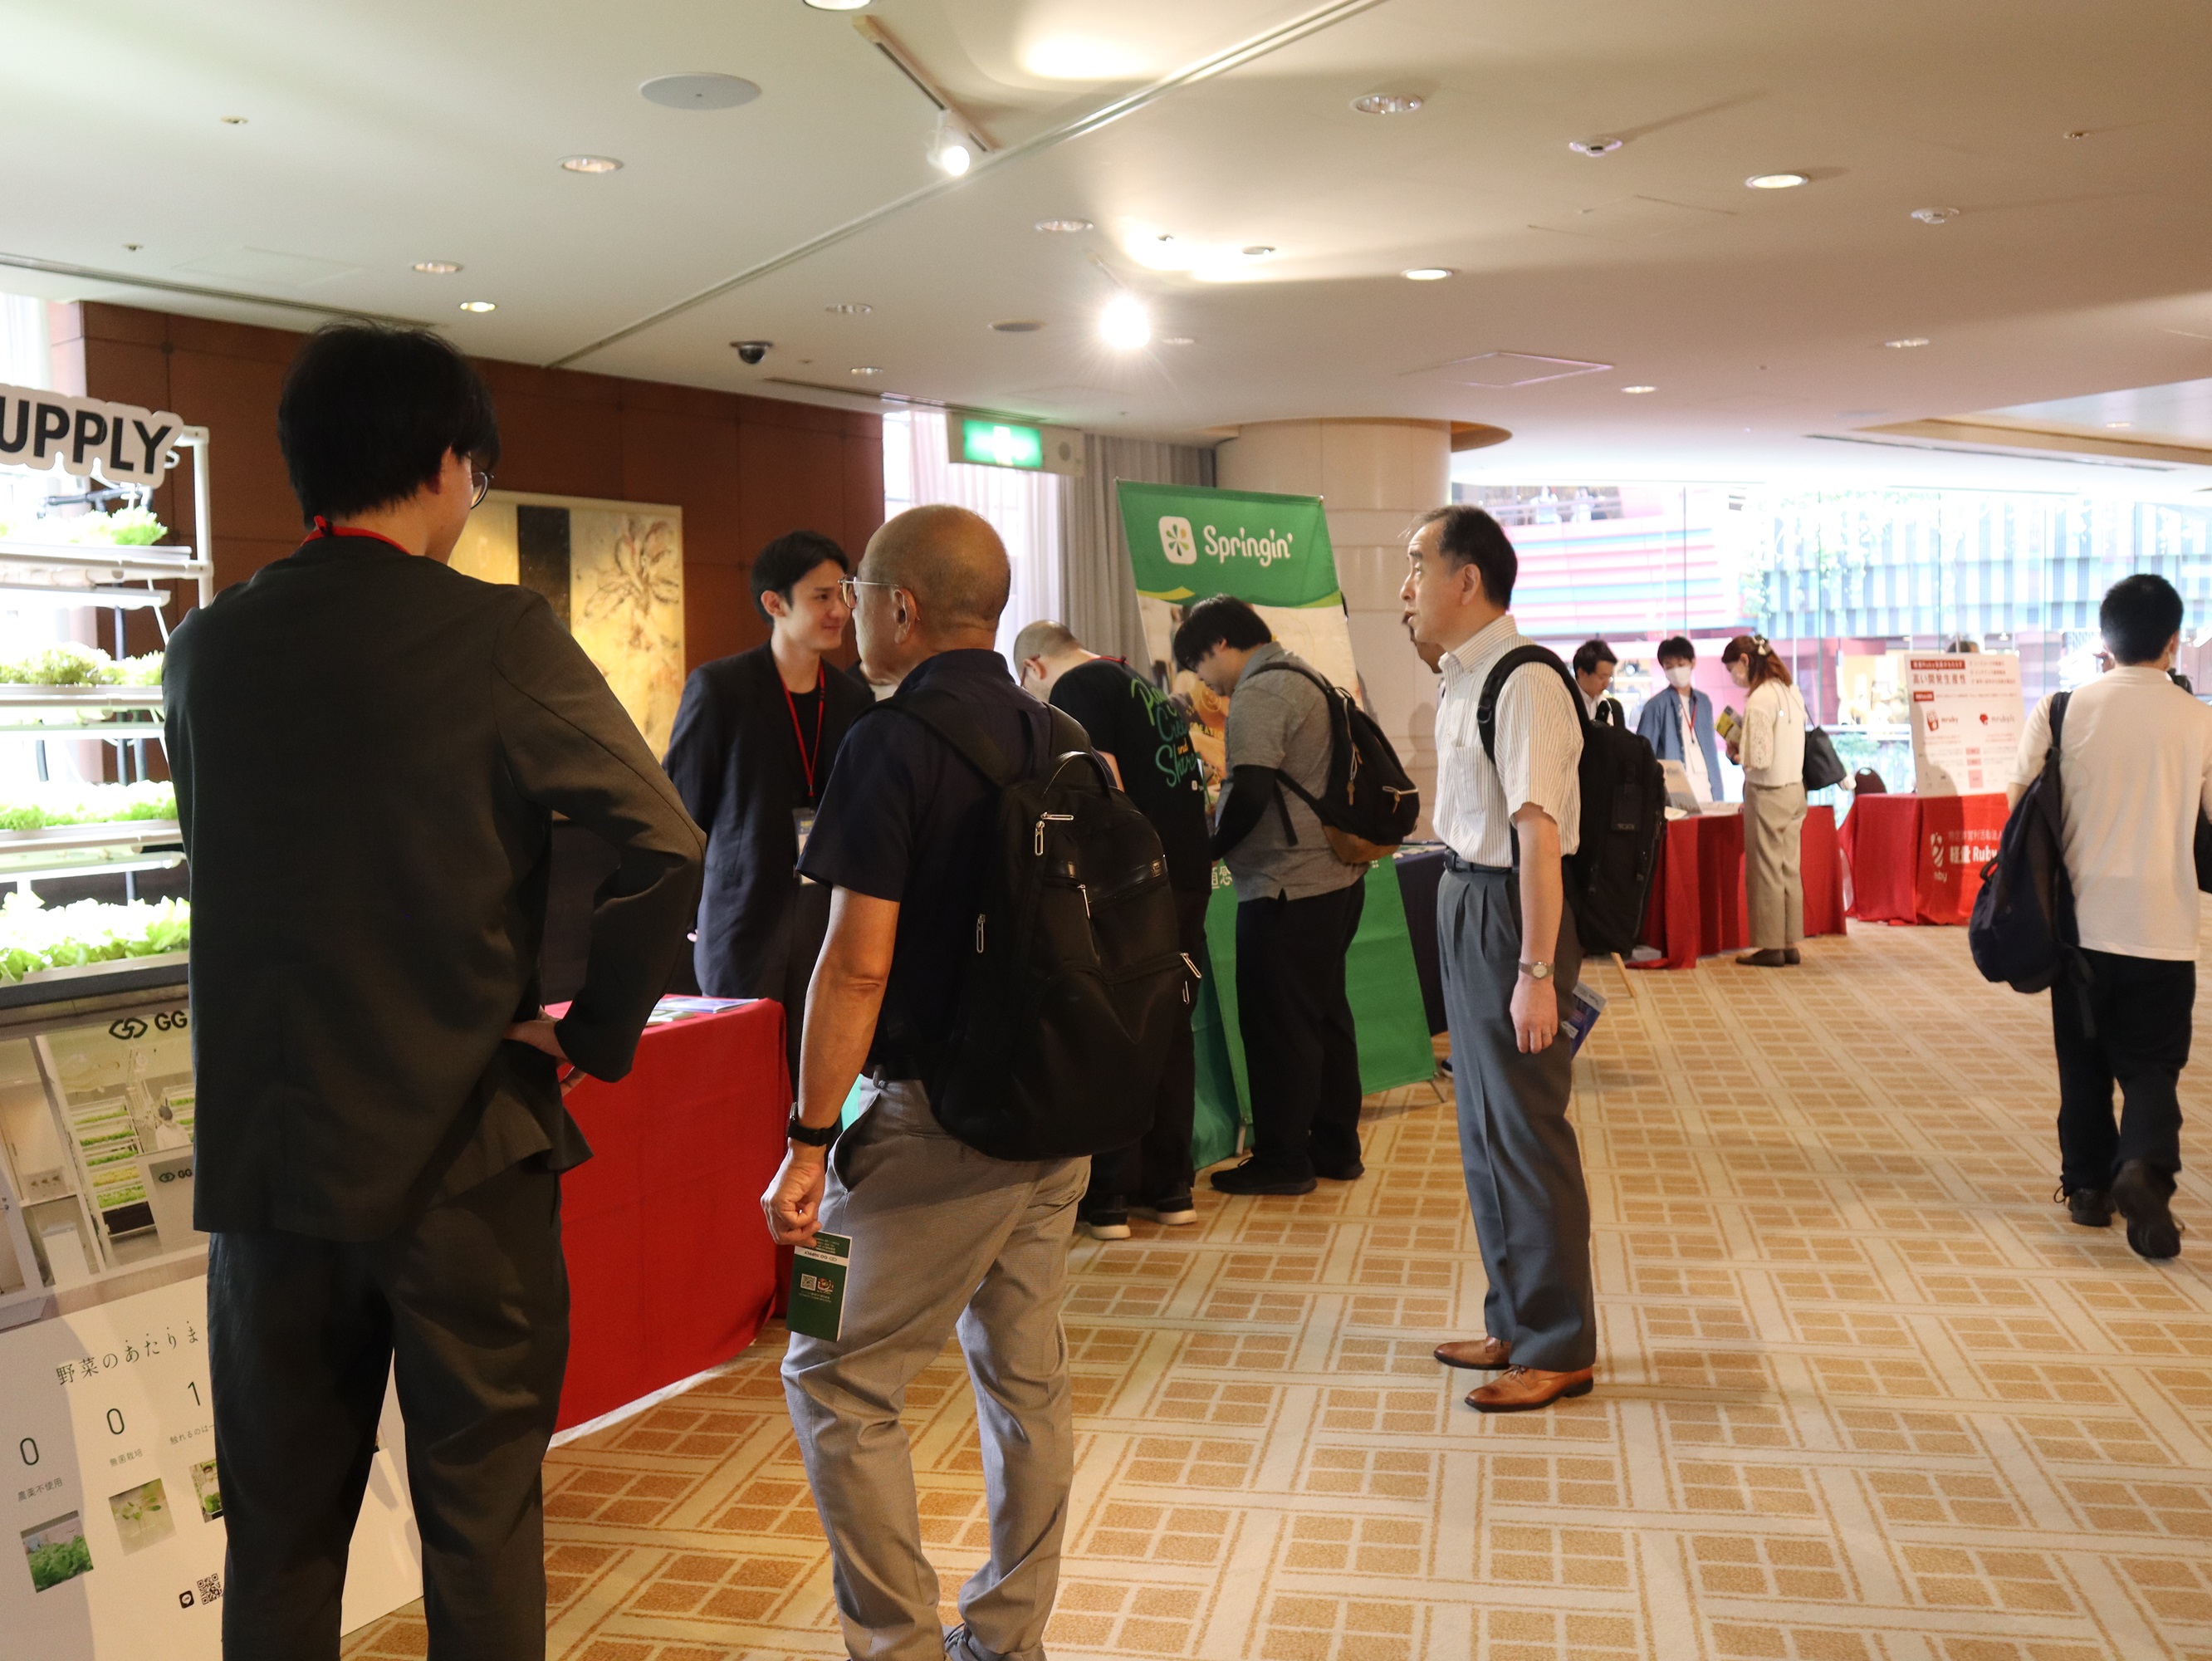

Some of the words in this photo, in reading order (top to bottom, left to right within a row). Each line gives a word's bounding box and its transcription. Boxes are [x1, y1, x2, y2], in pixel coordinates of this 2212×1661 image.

[1203, 524, 1294, 567] Springin'
[154, 1010, 188, 1031] GG
[178, 1169, 193, 1178] GG
[56, 1320, 199, 1386] 野菜のあたりま
[187, 1381, 202, 1406] 1
[106, 1408, 125, 1435] 0
[19, 1438, 40, 1466] 0
